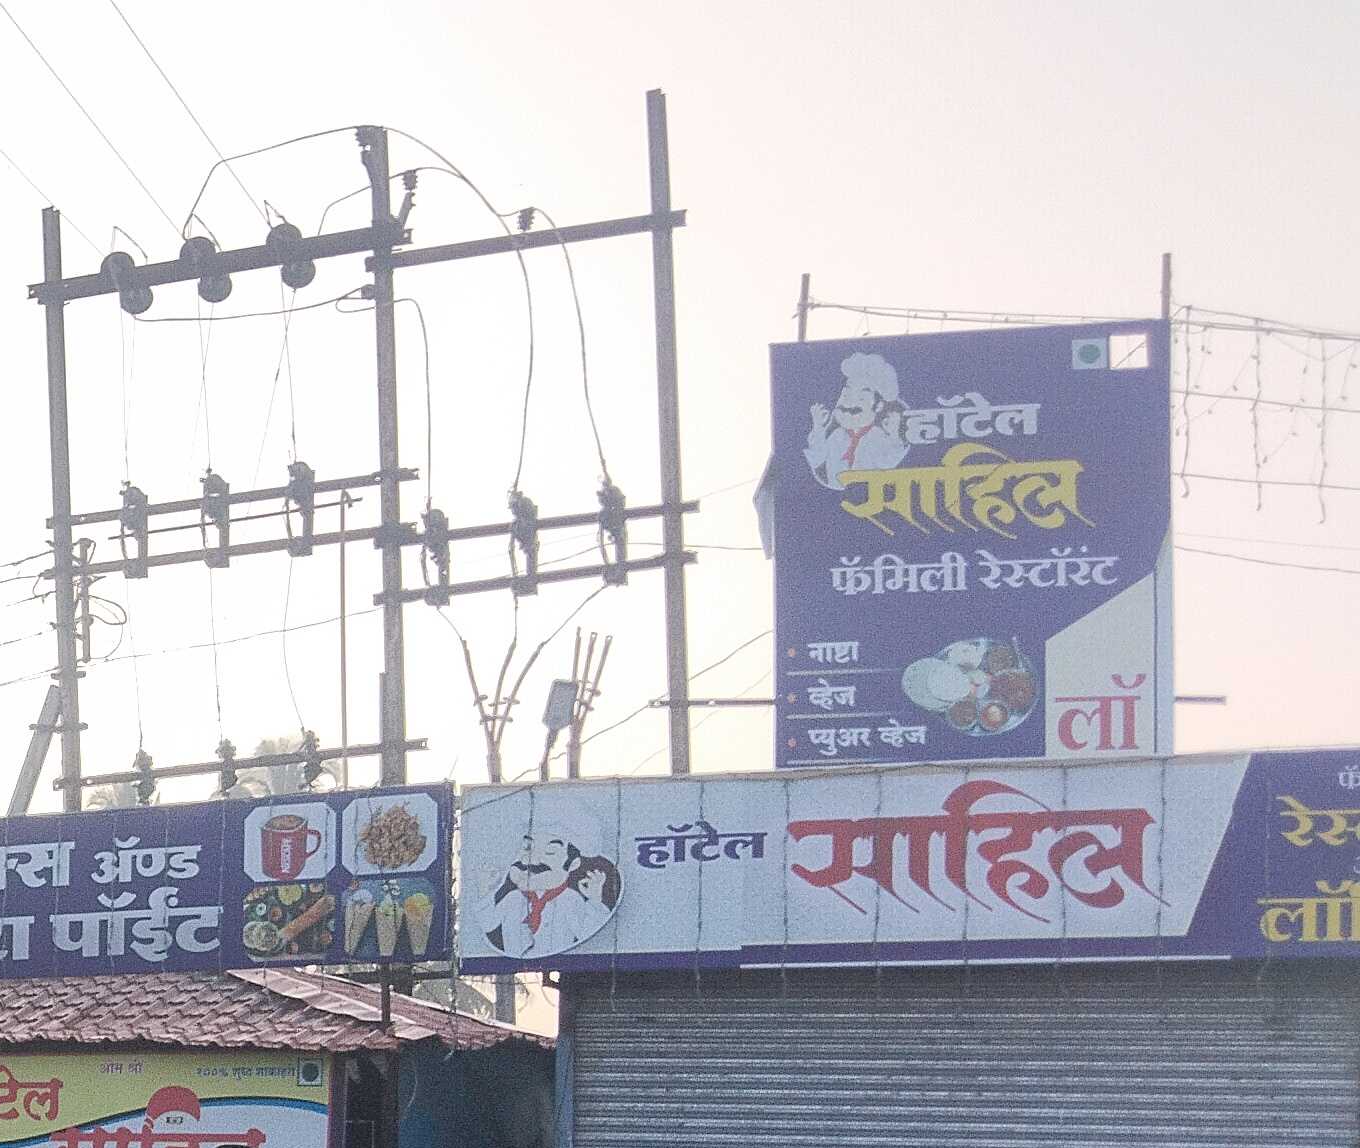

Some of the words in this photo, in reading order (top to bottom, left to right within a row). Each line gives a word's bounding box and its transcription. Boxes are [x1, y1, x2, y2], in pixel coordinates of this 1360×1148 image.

[903, 392, 1041, 444] हॉटेल
[837, 442, 1095, 539] साहिल
[830, 552, 967, 595] फॅमिली
[976, 546, 1119, 590] रेस्टॉरंट
[634, 820, 768, 870] हॉटेल
[786, 779, 1172, 923] साहिल
